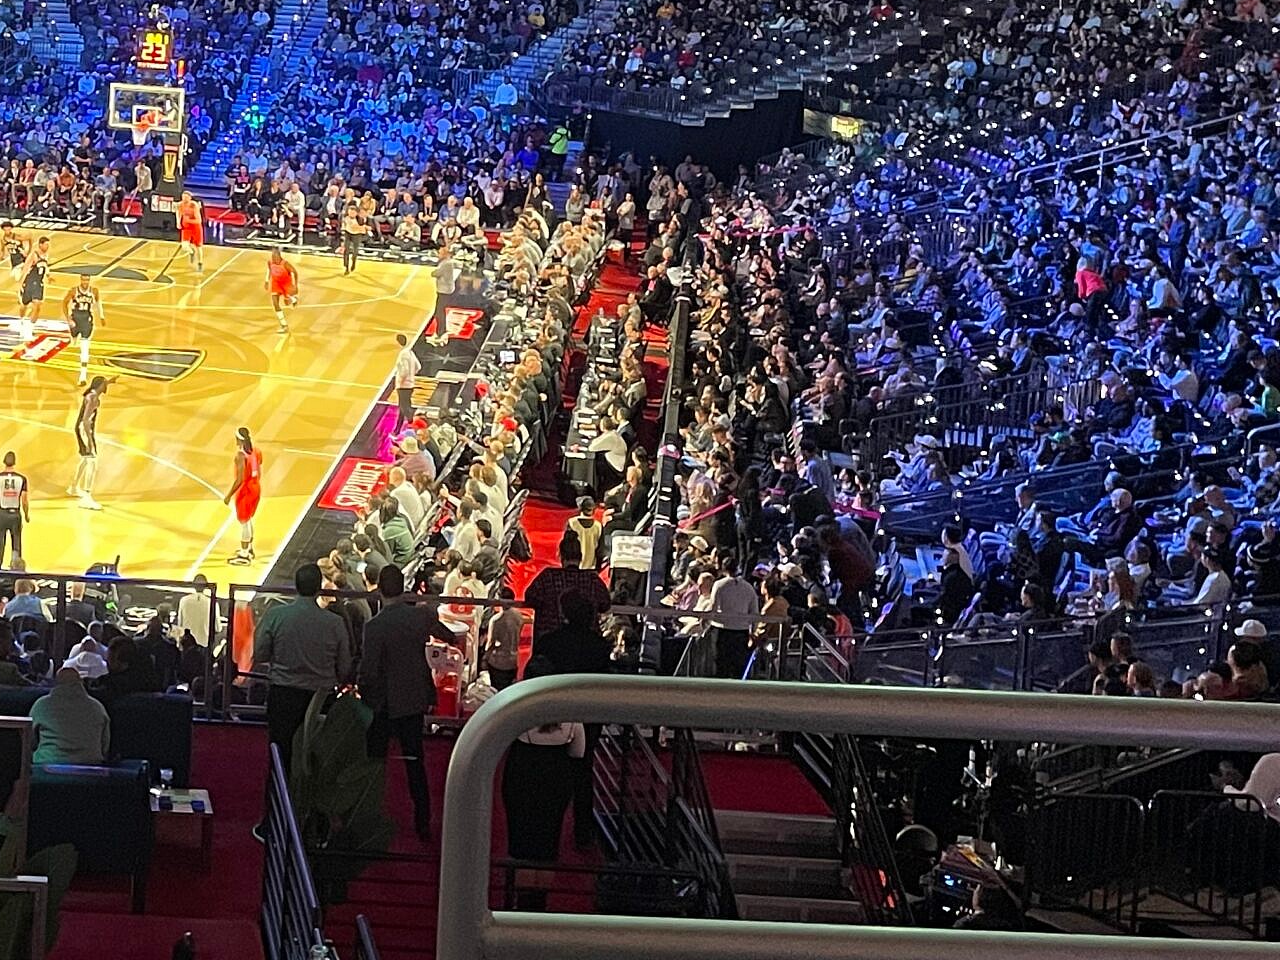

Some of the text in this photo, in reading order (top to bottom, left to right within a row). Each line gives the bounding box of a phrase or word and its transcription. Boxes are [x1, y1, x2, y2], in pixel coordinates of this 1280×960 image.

[141, 42, 166, 61] 23
[22, 219, 70, 230] CUP
[5, 479, 15, 489] 64
